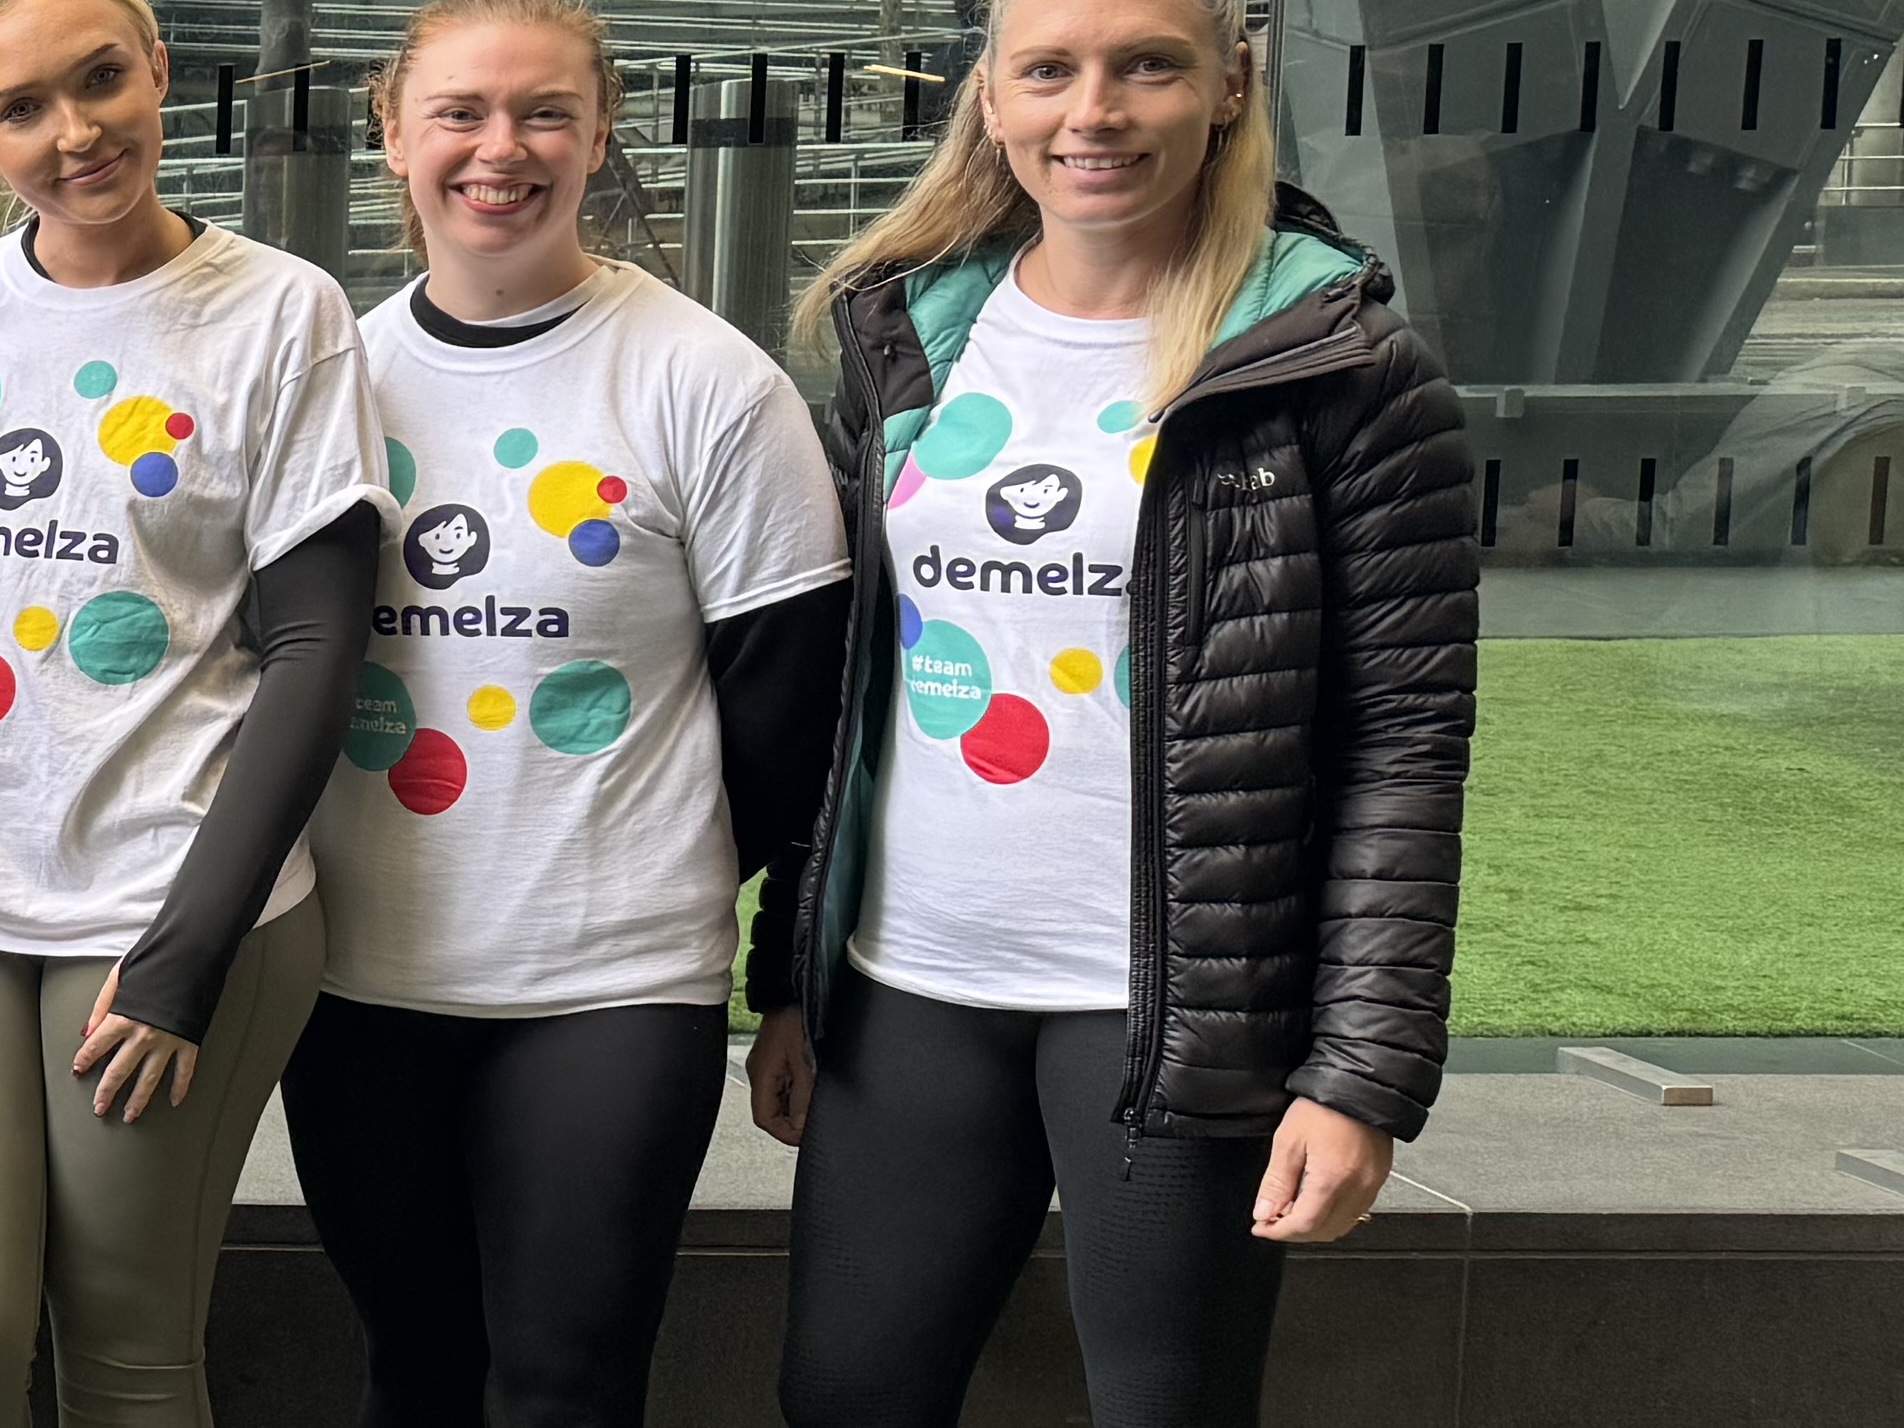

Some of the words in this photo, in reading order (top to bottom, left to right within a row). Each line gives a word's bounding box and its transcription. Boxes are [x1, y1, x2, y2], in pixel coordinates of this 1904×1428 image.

[913, 545, 1131, 597] demelz
[372, 594, 570, 638] emelza
[911, 655, 973, 677] #team
